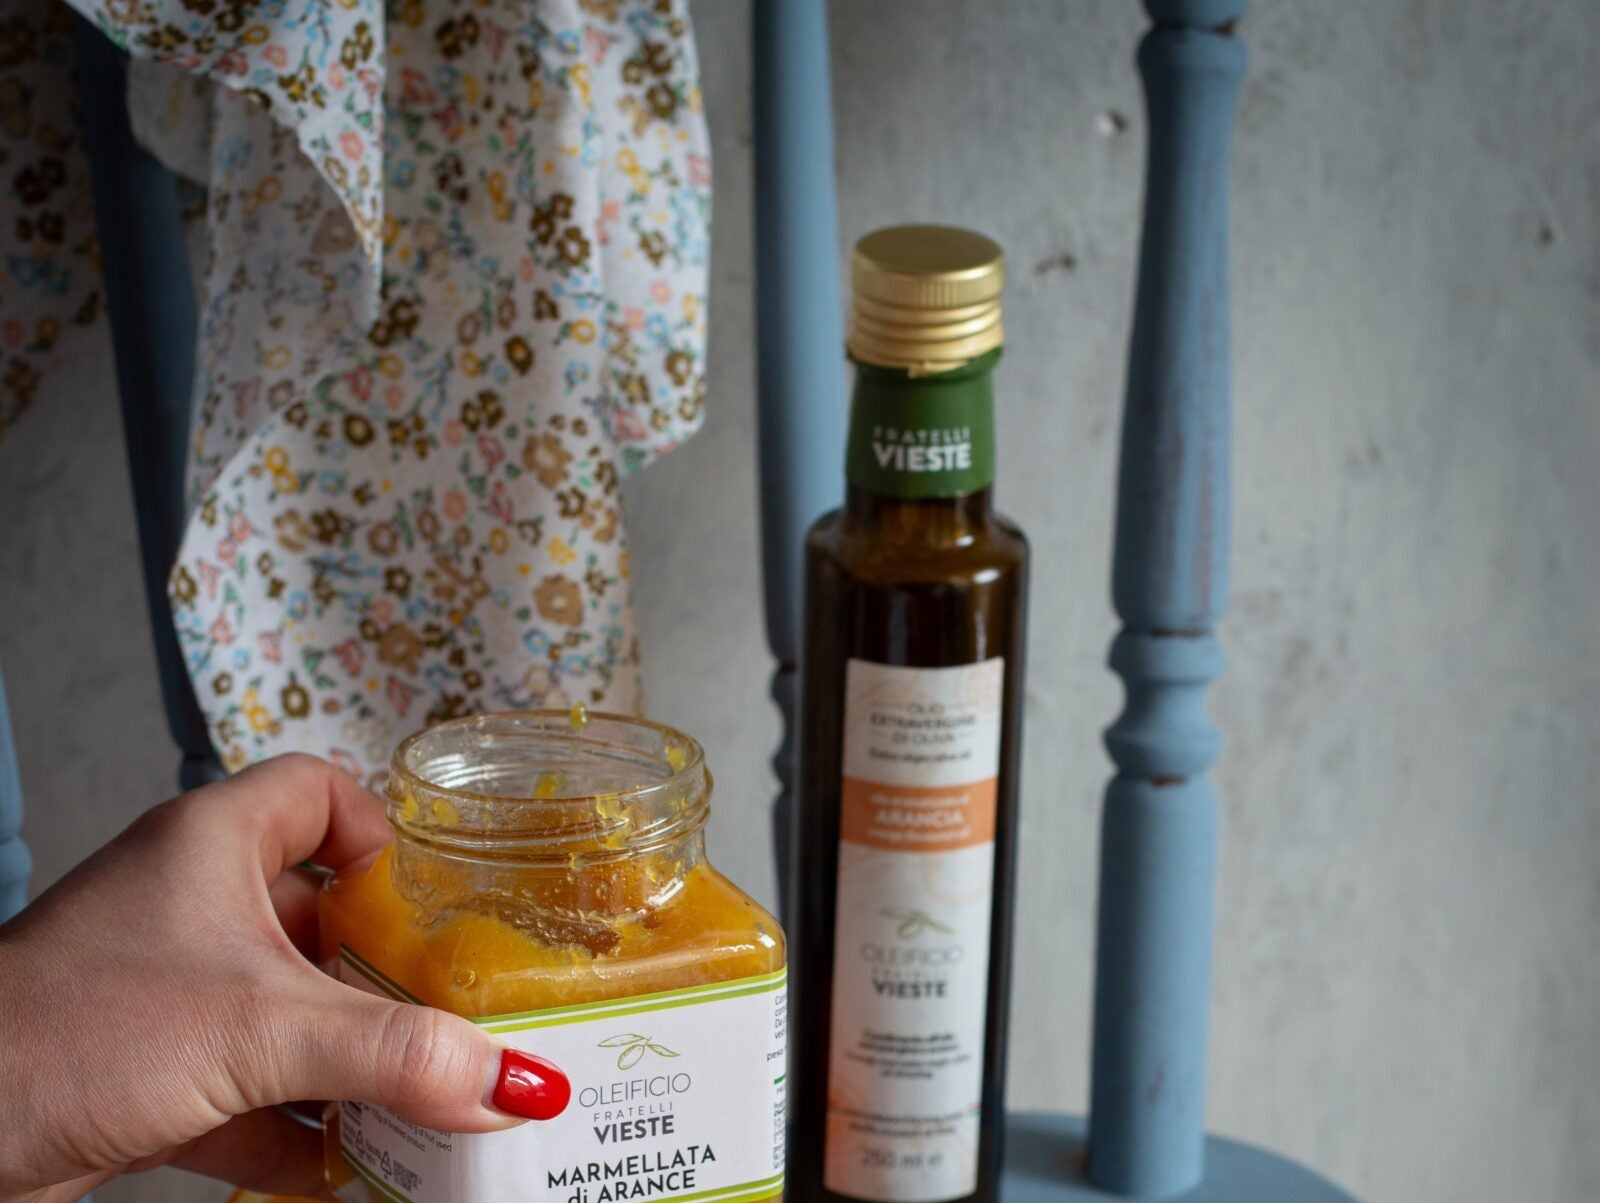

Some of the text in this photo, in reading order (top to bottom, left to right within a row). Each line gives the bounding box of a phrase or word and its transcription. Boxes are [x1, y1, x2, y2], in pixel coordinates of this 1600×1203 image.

[872, 426, 970, 444] FRATELLI
[872, 442, 972, 472] VIESTE
[875, 809, 965, 827] ARANCIA
[862, 943, 963, 965] OLEIFICIO
[872, 979, 947, 998] VIESTE
[578, 1072, 692, 1108] OLEIFICIO
[593, 1101, 673, 1123] FRATELLI
[593, 1114, 675, 1145] VIESTE
[547, 1144, 716, 1189] MARMELLATA
